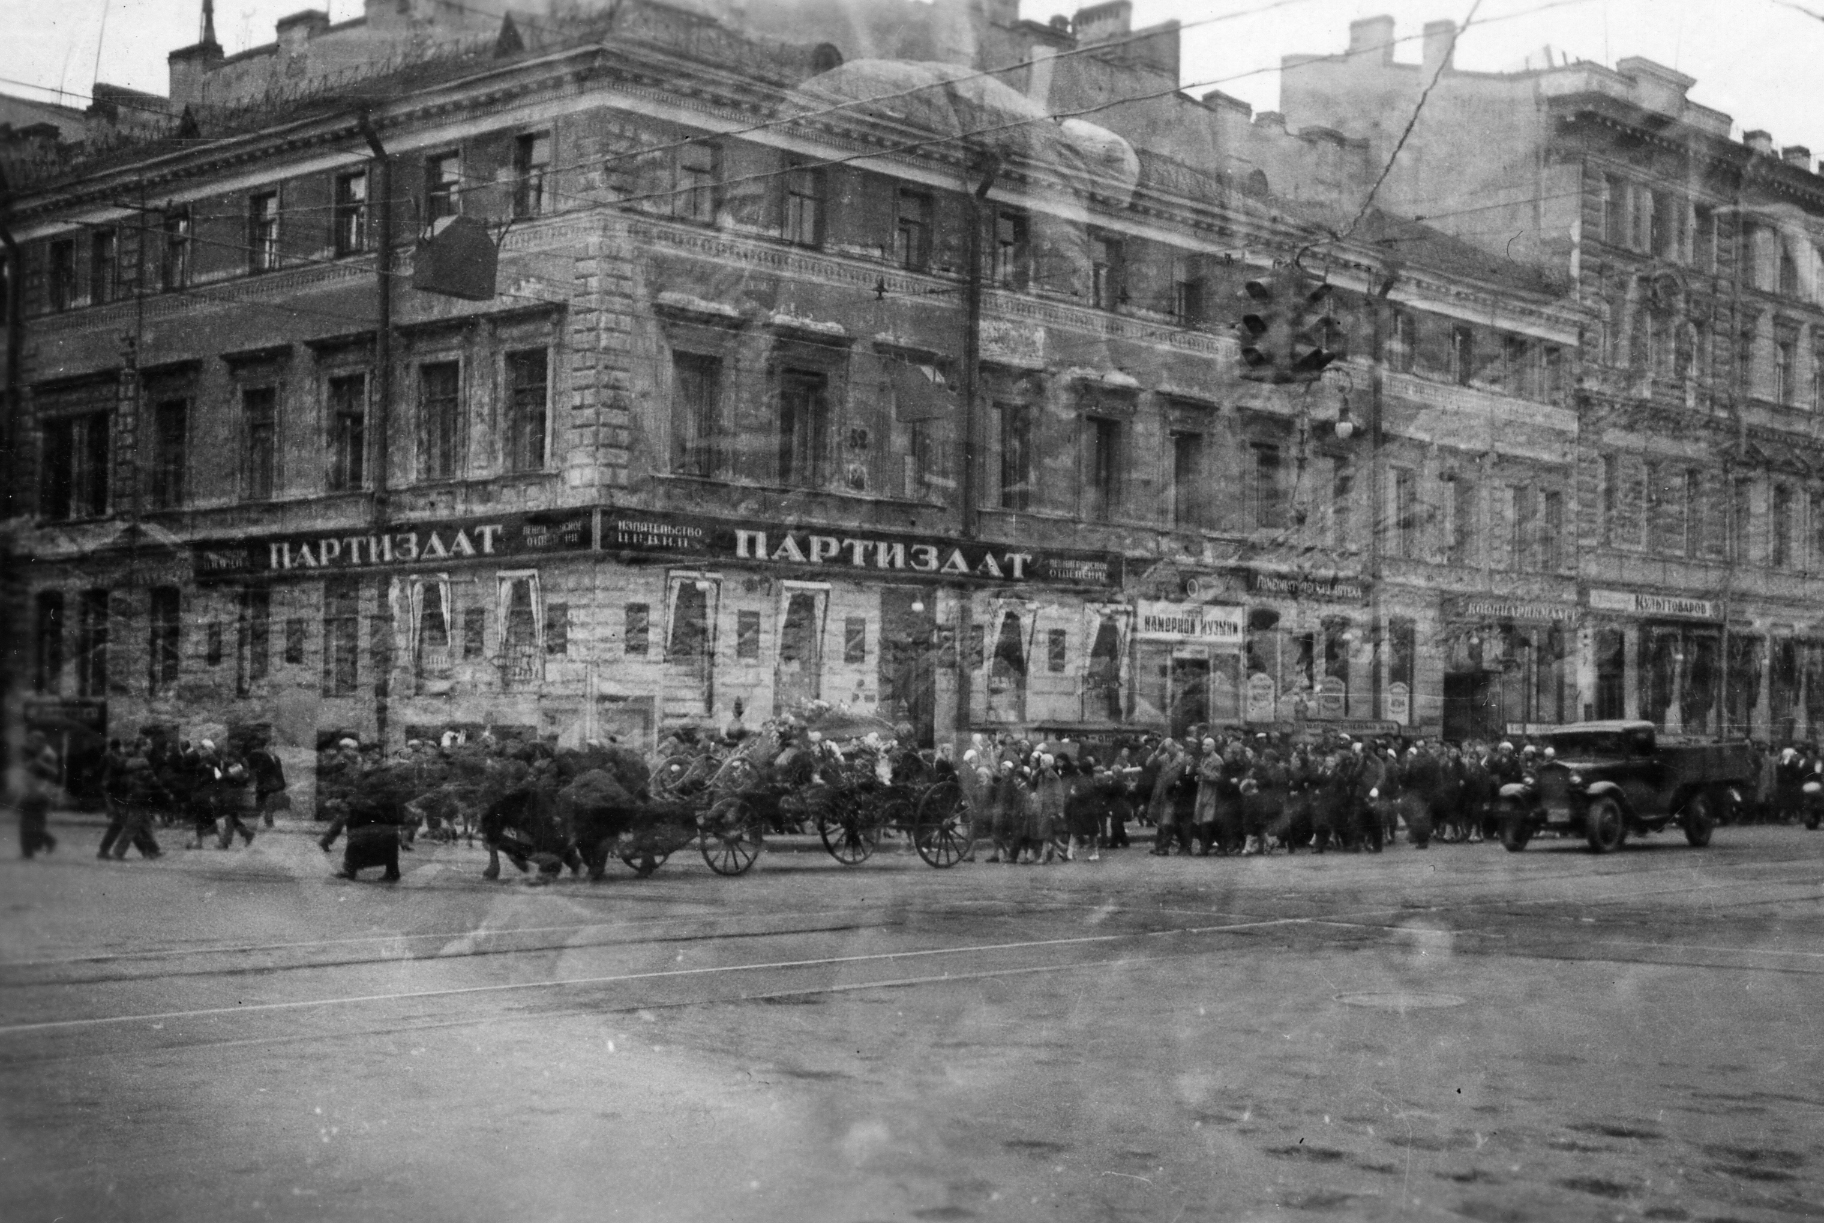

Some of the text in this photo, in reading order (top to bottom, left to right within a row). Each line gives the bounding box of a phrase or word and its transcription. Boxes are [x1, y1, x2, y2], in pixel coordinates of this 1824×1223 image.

[268, 523, 503, 570] ПАРТИЗДАТ
[617, 520, 703, 537] ИЗДАТЕЛЬСТВО
[734, 527, 1033, 580] ПАРТИЗДАТ
